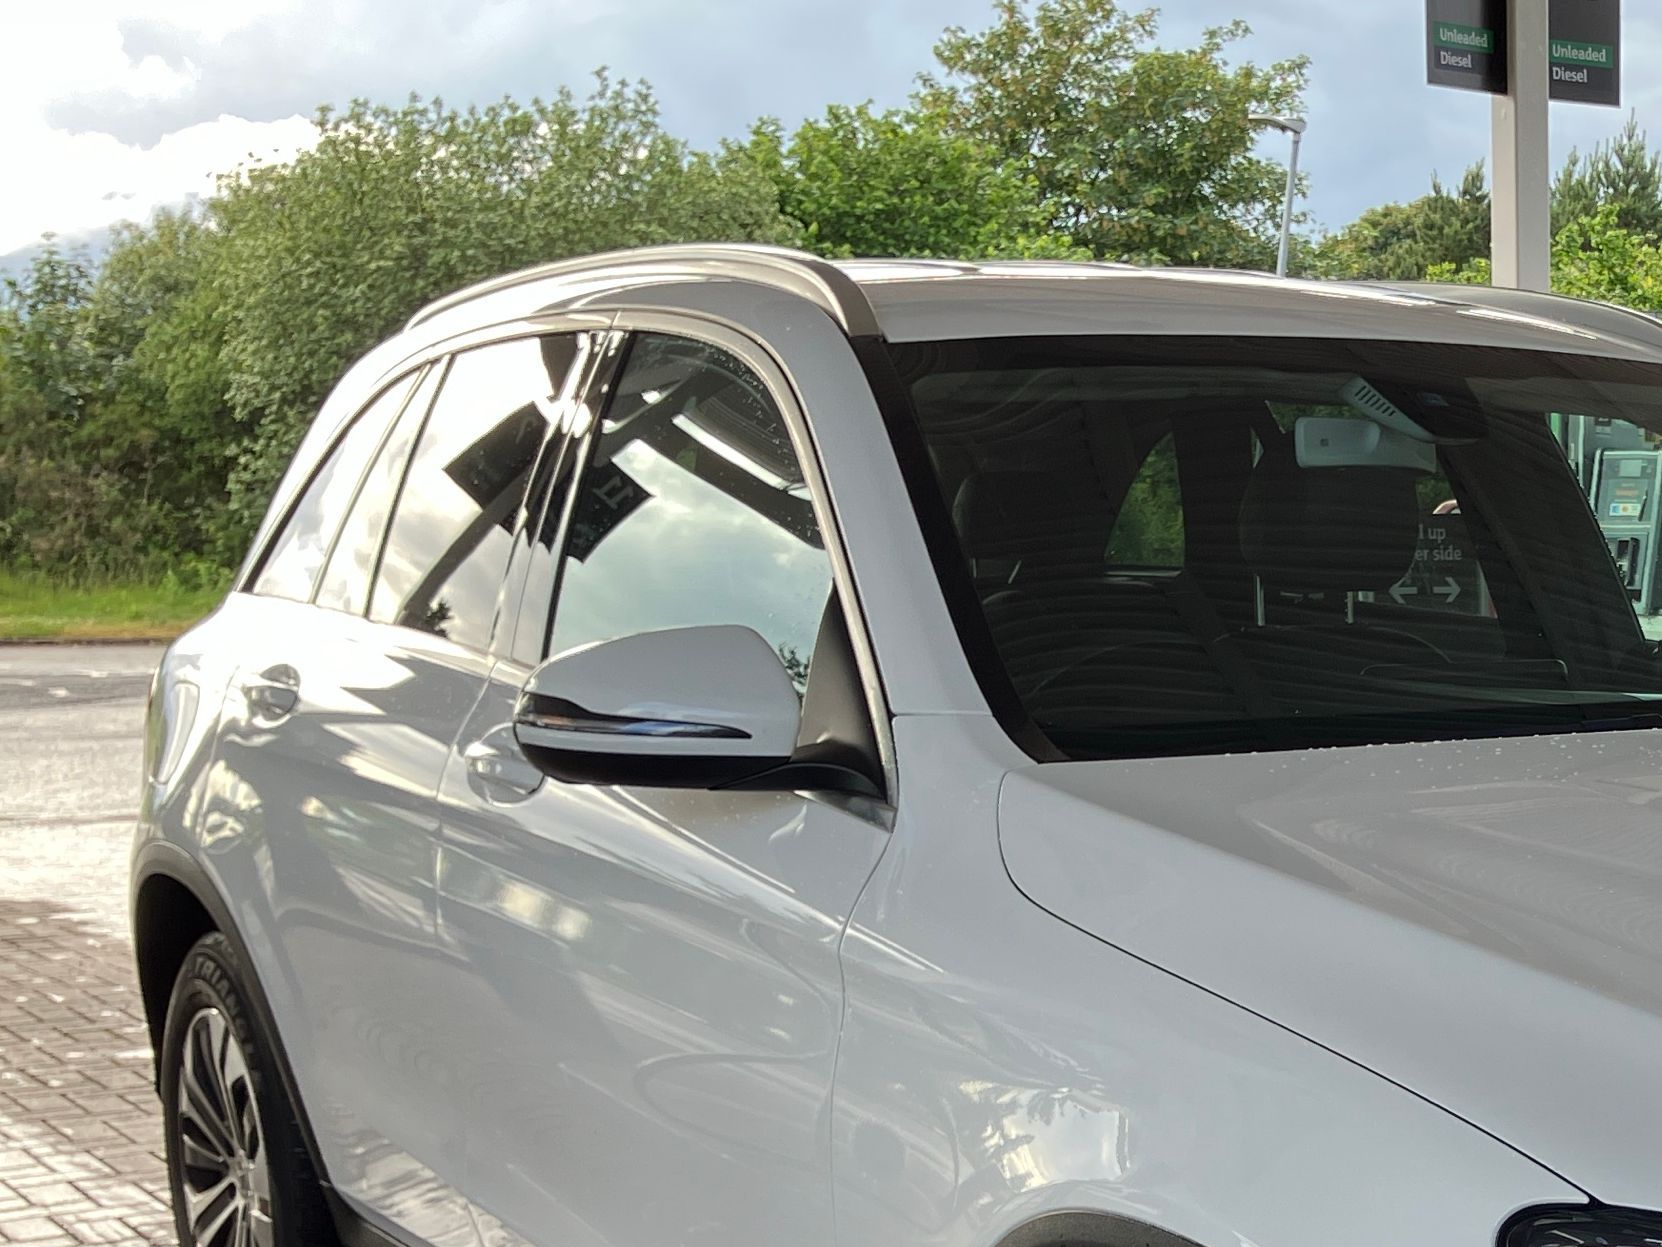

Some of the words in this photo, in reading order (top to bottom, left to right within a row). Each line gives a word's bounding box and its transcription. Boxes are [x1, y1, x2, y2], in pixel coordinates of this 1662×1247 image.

[1439, 28, 1488, 48] Unleaded
[1440, 51, 1472, 69] Diesel
[1552, 44, 1607, 63] Unleaded
[1552, 67, 1588, 83] Diesel
[1428, 528, 1446, 544] up
[1432, 544, 1462, 561] side
